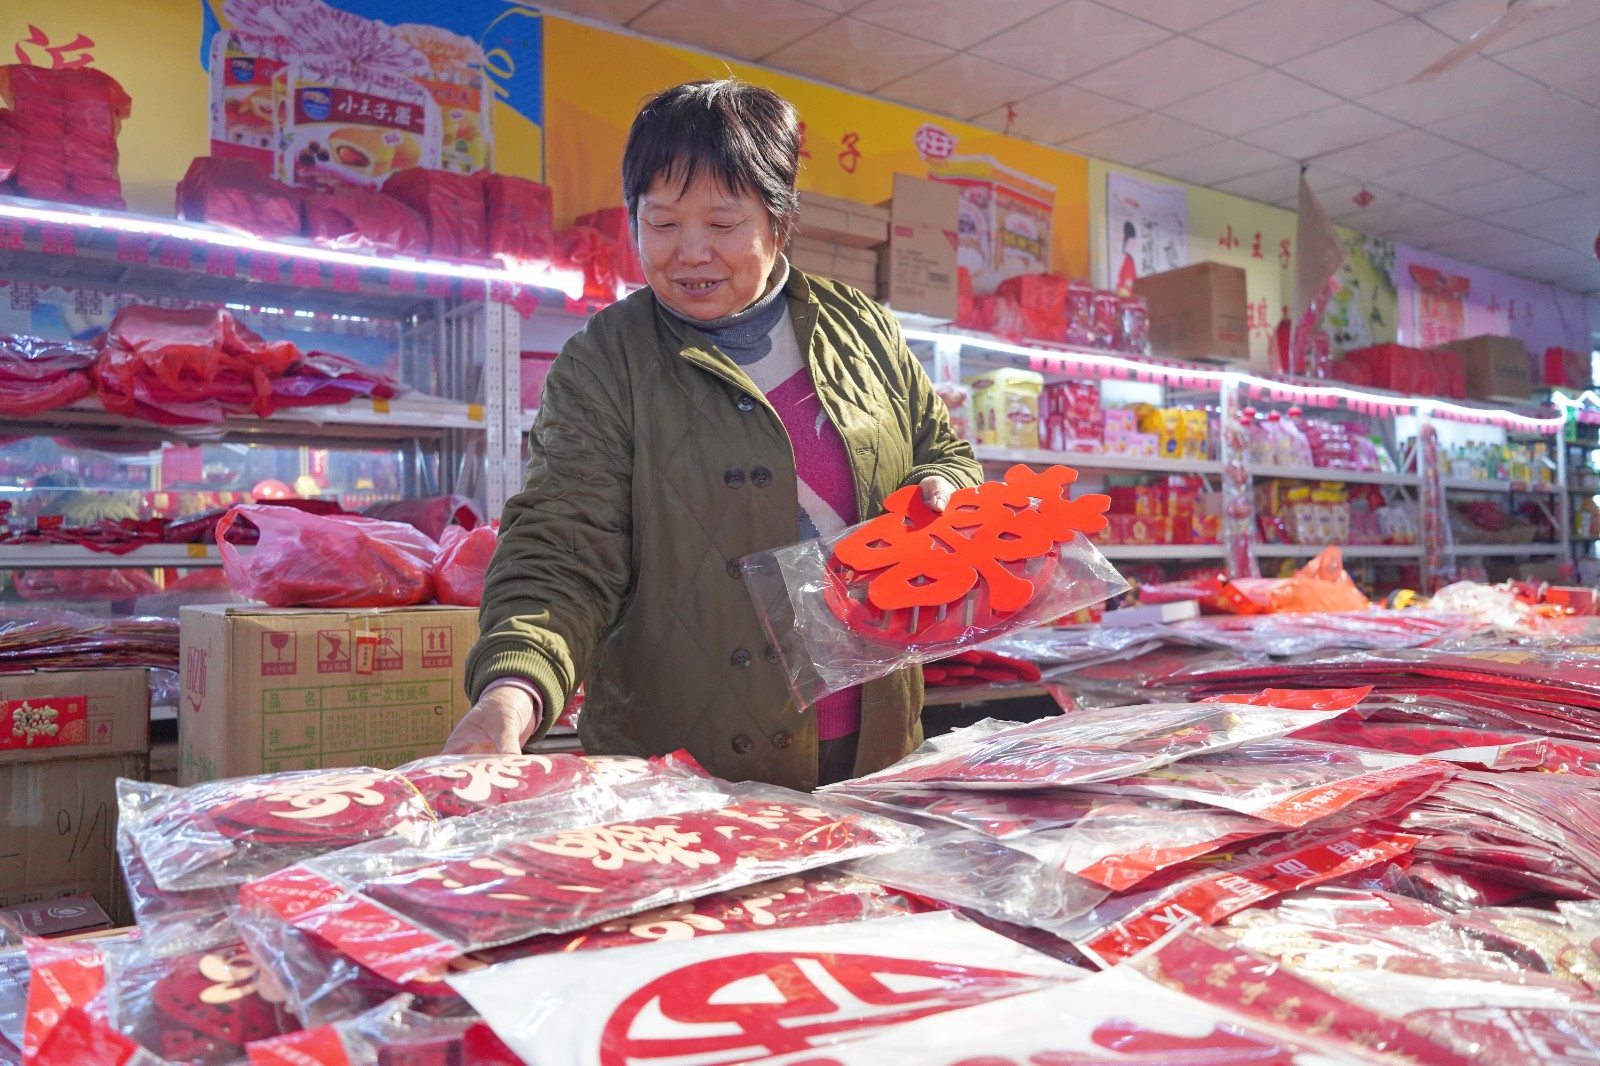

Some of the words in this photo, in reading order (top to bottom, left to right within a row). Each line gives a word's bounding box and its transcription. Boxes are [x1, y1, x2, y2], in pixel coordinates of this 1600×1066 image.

[1219, 224, 1291, 269] 小王子
[265, 666, 294, 674] 小心轻放
[269, 691, 315, 709] 品名
[346, 685, 429, 703] 环保一次性纸杯
[268, 726, 315, 744] 货号
